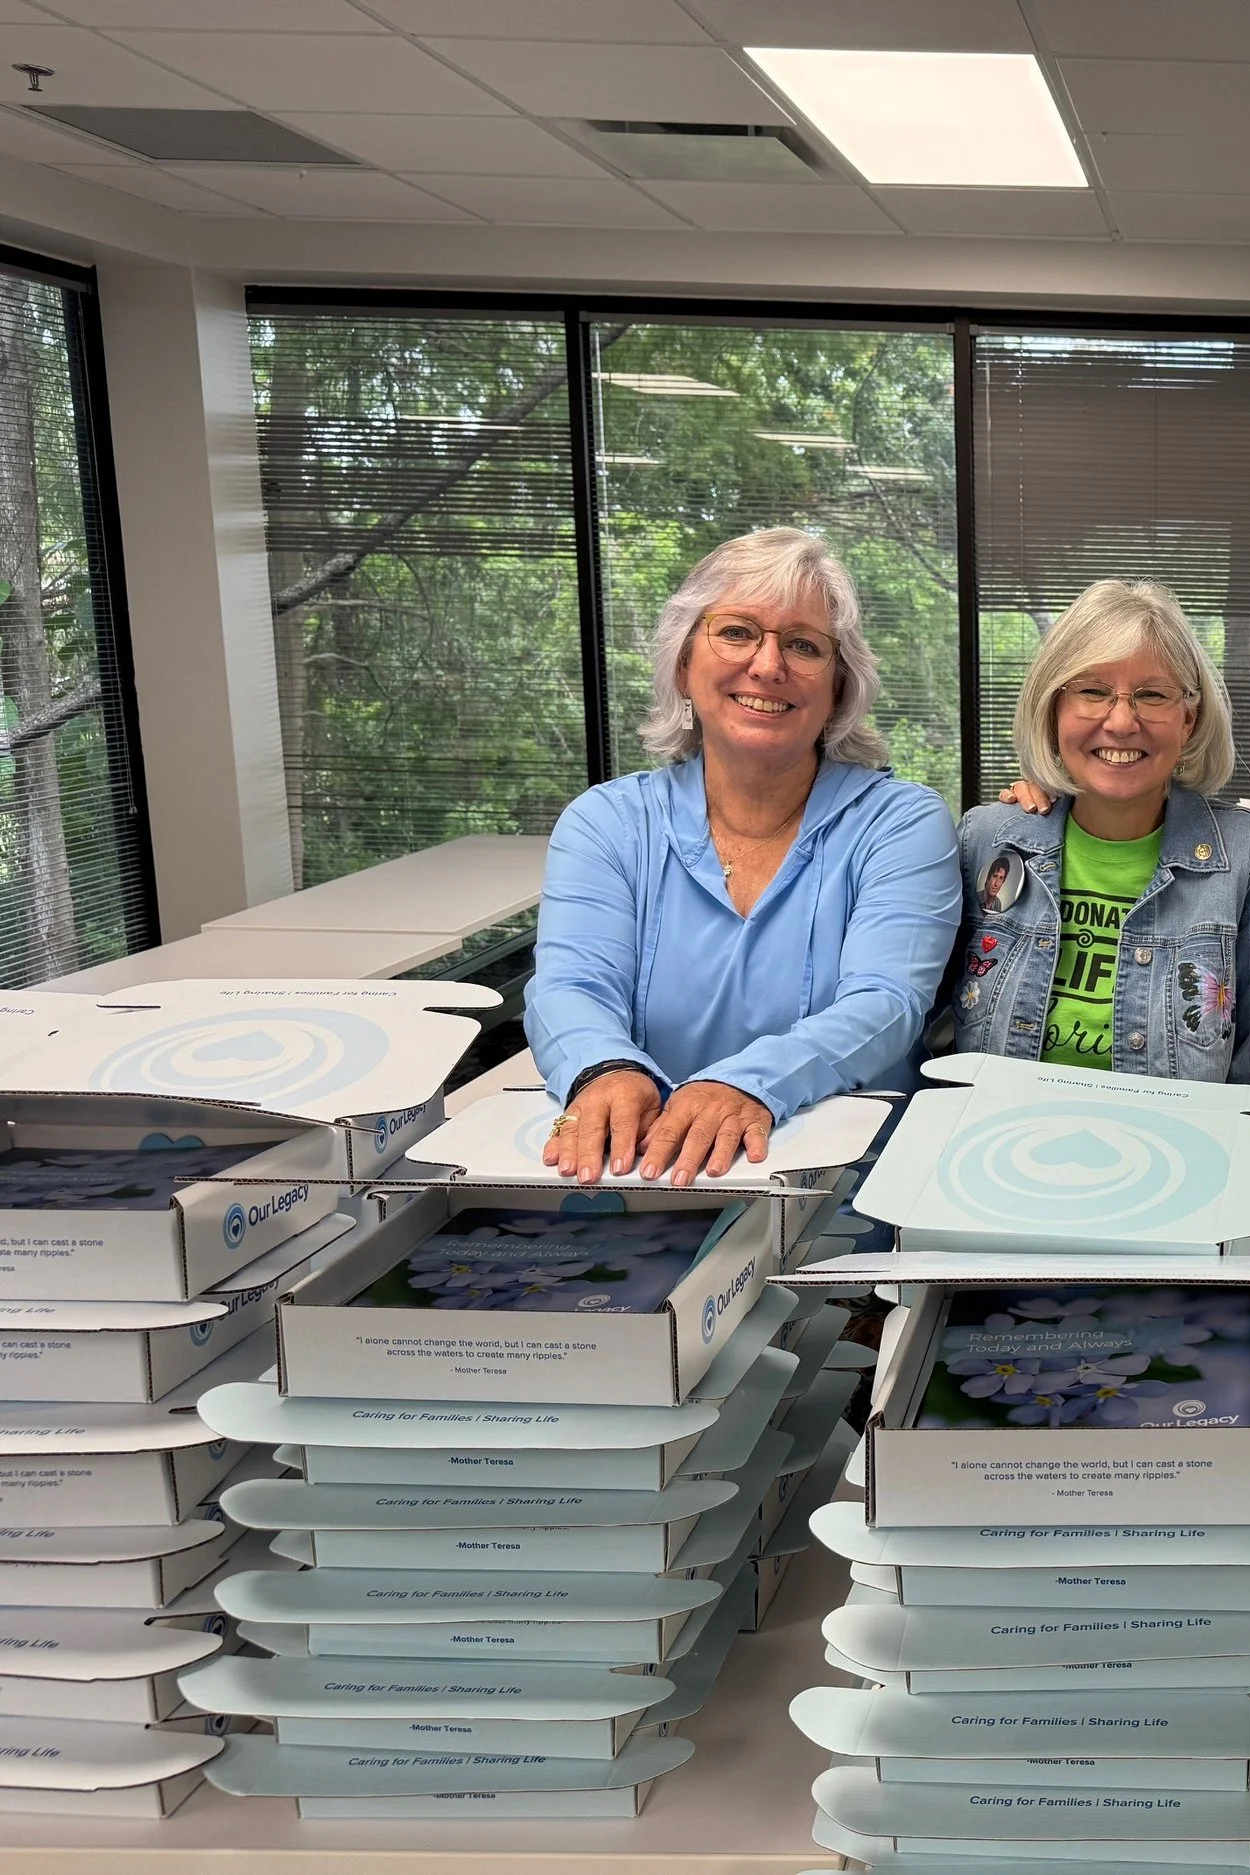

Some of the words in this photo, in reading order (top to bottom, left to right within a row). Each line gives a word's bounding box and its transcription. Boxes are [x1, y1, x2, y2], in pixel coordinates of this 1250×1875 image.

[1056, 1078, 1093, 1088] Sharing
[1100, 1084, 1140, 1093] Families
[1157, 1090, 1189, 1098] Caring
[249, 1202, 271, 1226] Our
[272, 1184, 309, 1214] Legacy
[717, 1288, 731, 1316] Our
[731, 1256, 756, 1299] Legacy
[970, 1330, 1104, 1342] Remembering
[966, 1344, 1021, 1354] Today
[1026, 1342, 1062, 1351] and
[1068, 1339, 1133, 1350] Always
[352, 1410, 396, 1421] Caring
[397, 1412, 418, 1420] for
[418, 1413, 473, 1422] Families
[482, 1414, 533, 1424] Sharing
[534, 1415, 560, 1423] Life
[1176, 1415, 1239, 1427] Legacy
[447, 1456, 482, 1465] -Mother
[483, 1457, 514, 1465] Teresa
[960, 1461, 988, 1469] alone
[989, 1461, 1023, 1469] cannot
[1024, 1460, 1061, 1470] change
[1062, 1460, 1078, 1468] the
[1080, 1460, 1110, 1469] world,
[1112, 1460, 1129, 1468] but
[1135, 1460, 1153, 1469] can
[1155, 1459, 1176, 1468] cast
[1185, 1459, 1213, 1468] stone
[983, 1473, 1015, 1481] across
[1017, 1471, 1033, 1480] the
[1034, 1472, 1067, 1480] waters
[1069, 1471, 1080, 1480] to
[1081, 1471, 1112, 1480] create
[1114, 1472, 1140, 1481] many
[1056, 1489, 1085, 1497] Mother
[1086, 1488, 1113, 1497] Teresa
[375, 1498, 419, 1507] Caring
[421, 1497, 441, 1506] for
[442, 1497, 496, 1505] Families
[506, 1497, 556, 1506] Sharing
[558, 1497, 582, 1505] Life
[978, 1527, 1027, 1539] Caring
[1030, 1527, 1050, 1537] for
[1053, 1529, 1111, 1537] Families
[1122, 1529, 1176, 1538] Sharing
[1180, 1529, 1205, 1537] Life
[1055, 1576, 1092, 1585] -Mother
[1093, 1577, 1126, 1585] Teresa
[366, 1589, 408, 1599] Caring
[410, 1590, 430, 1598] for
[431, 1589, 485, 1598] Families
[493, 1590, 542, 1598] Sharing
[544, 1589, 569, 1598] Life
[990, 1625, 1036, 1635] Caring
[1040, 1624, 1060, 1632] for
[1063, 1622, 1120, 1632] Families
[1130, 1619, 1183, 1629] Sharing
[1187, 1617, 1212, 1626] Life
[324, 1682, 366, 1692] Caring
[367, 1683, 387, 1691] for
[387, 1684, 440, 1693] Families
[447, 1685, 497, 1695] Sharing
[498, 1686, 522, 1694] Life
[951, 1715, 996, 1727] Caring
[999, 1716, 1019, 1725] for
[1021, 1716, 1077, 1726] Families
[1088, 1717, 1140, 1728] Sharing
[1143, 1718, 1168, 1726] Life
[969, 1795, 1013, 1807] Caring
[1016, 1796, 1036, 1806] for
[1038, 1797, 1092, 1807] Families
[1102, 1798, 1153, 1809] Sharing
[1157, 1799, 1181, 1808] Life
